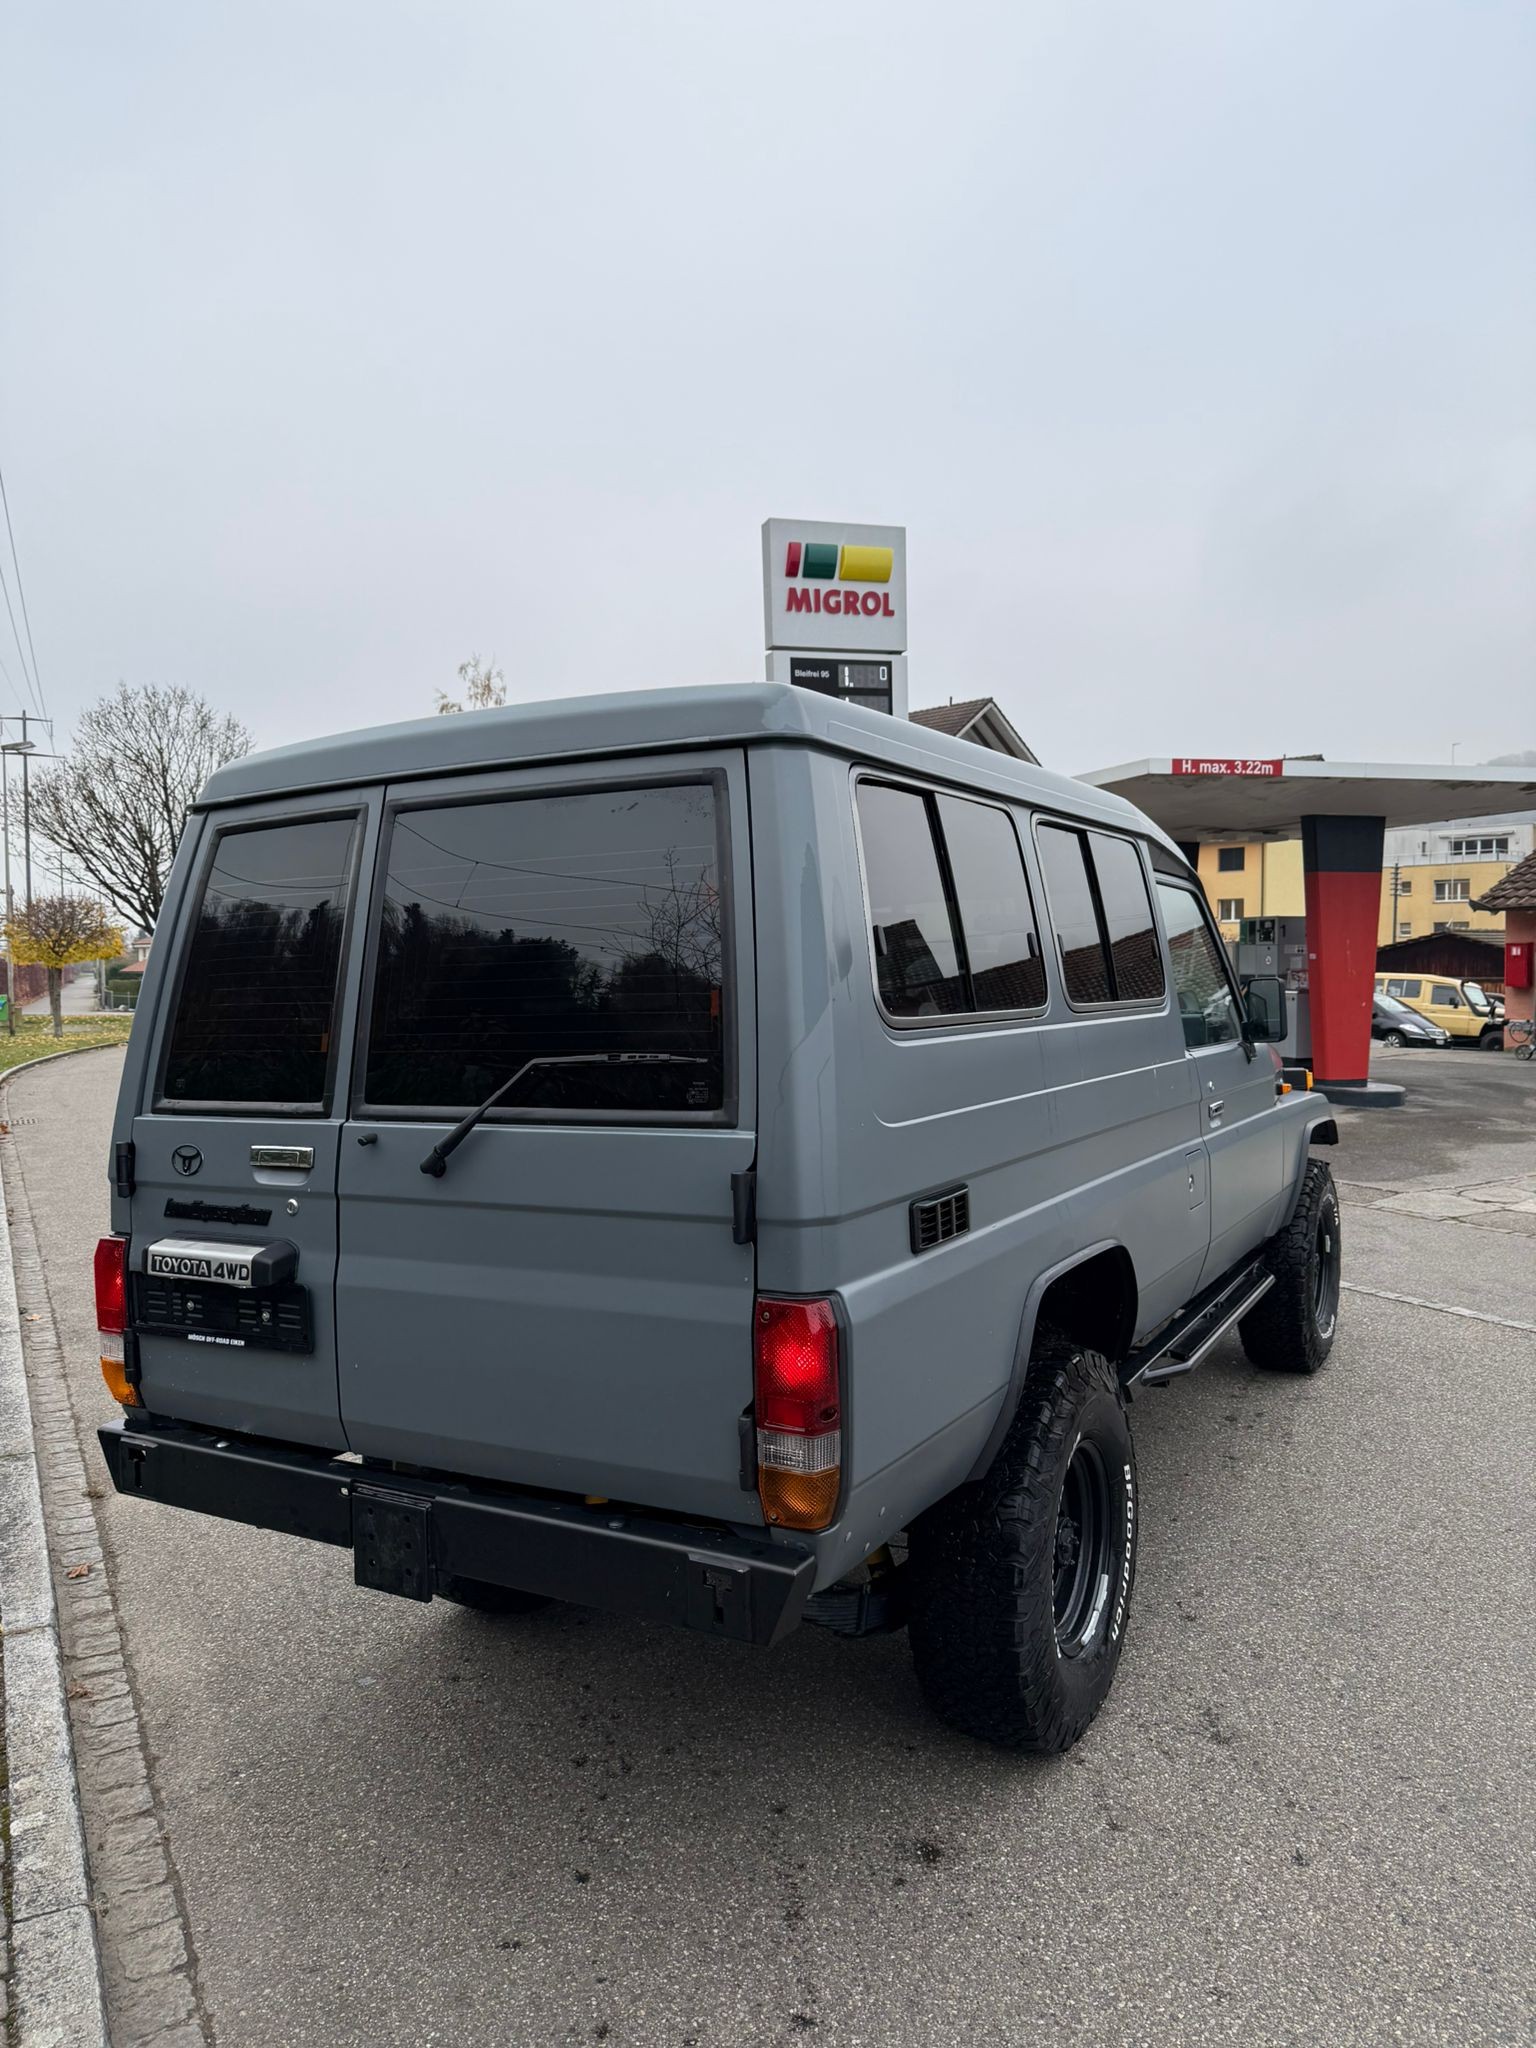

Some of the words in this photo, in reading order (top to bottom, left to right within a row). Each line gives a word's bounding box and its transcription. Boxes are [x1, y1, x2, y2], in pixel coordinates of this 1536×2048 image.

[786, 587, 895, 617] MIGROL
[794, 669, 820, 678] Bleifrei
[821, 671, 830, 679] 95
[1182, 760, 1196, 773] H.
[1199, 762, 1231, 774] max.
[1234, 761, 1273, 775] 3.22m
[153, 1255, 209, 1277] TOYOTA
[213, 1261, 249, 1281] 4WD
[1112, 1464, 1134, 1641] BFGoodrich
